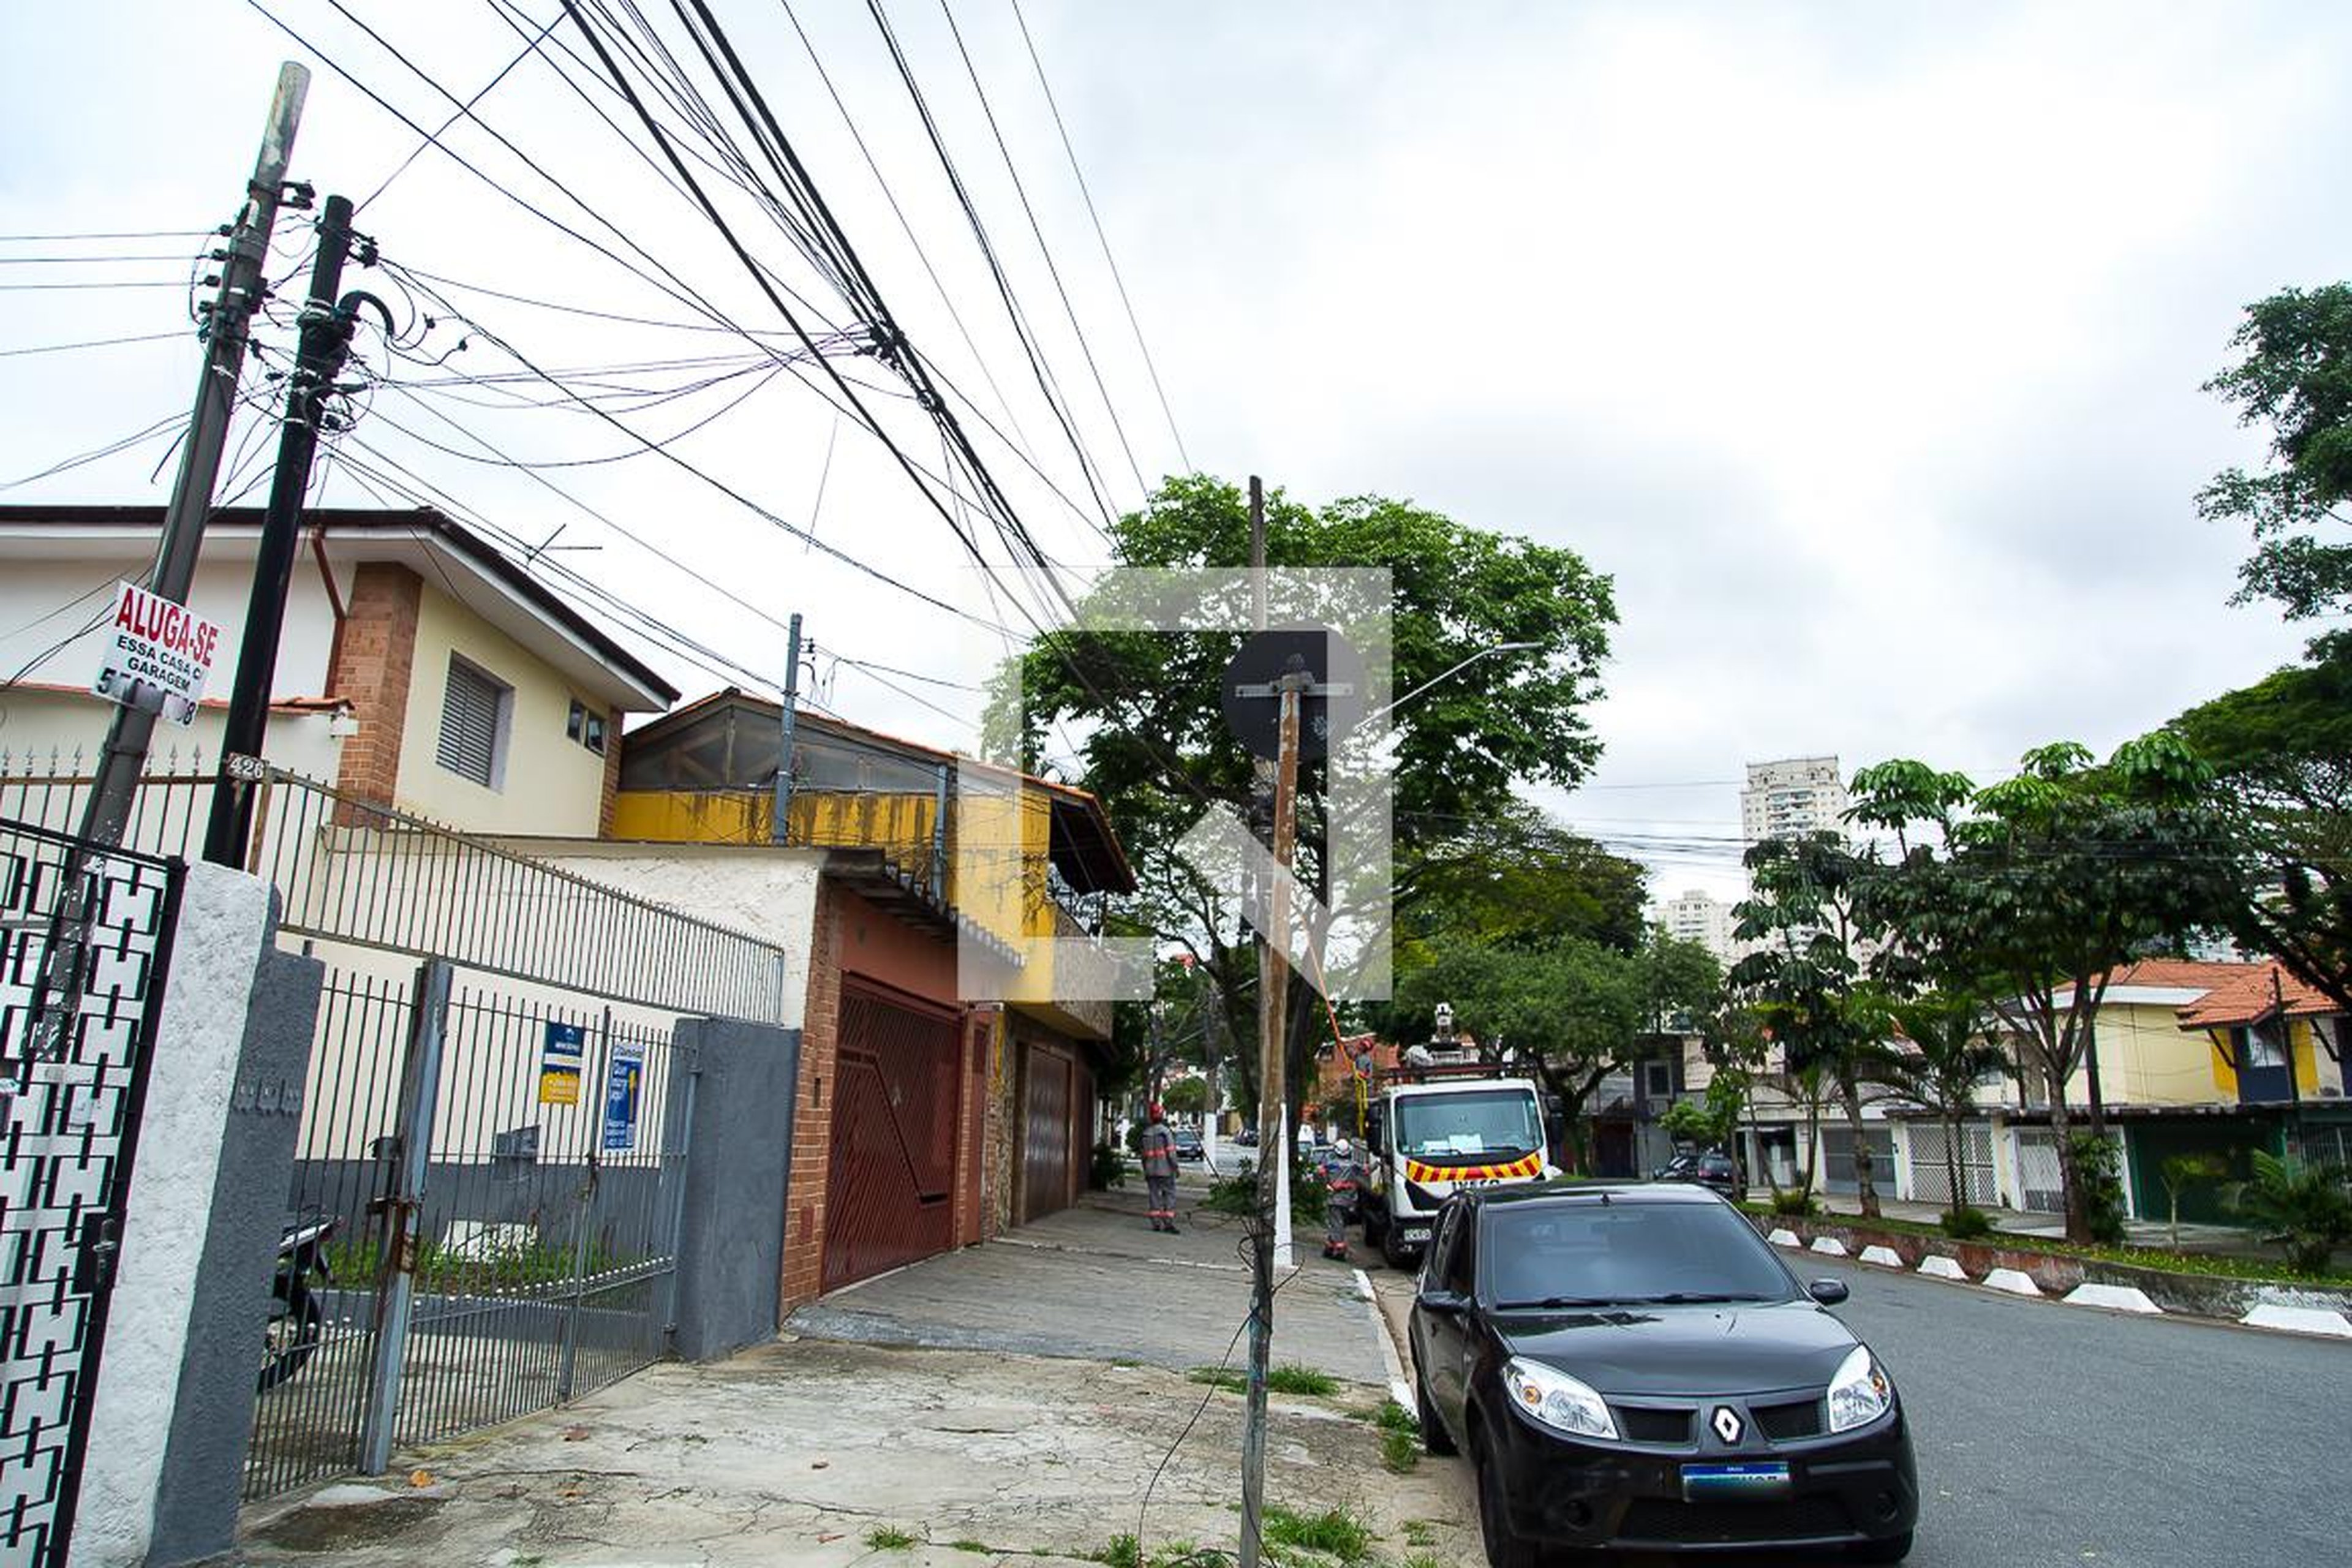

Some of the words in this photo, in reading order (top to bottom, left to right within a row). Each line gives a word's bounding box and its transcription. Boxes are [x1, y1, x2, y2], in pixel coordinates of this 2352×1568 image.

[115, 587, 218, 668] ALUGA-SE
[117, 635, 156, 660] ESSA
[160, 652, 191, 673] CASA
[128, 657, 190, 693] GARAGEM
